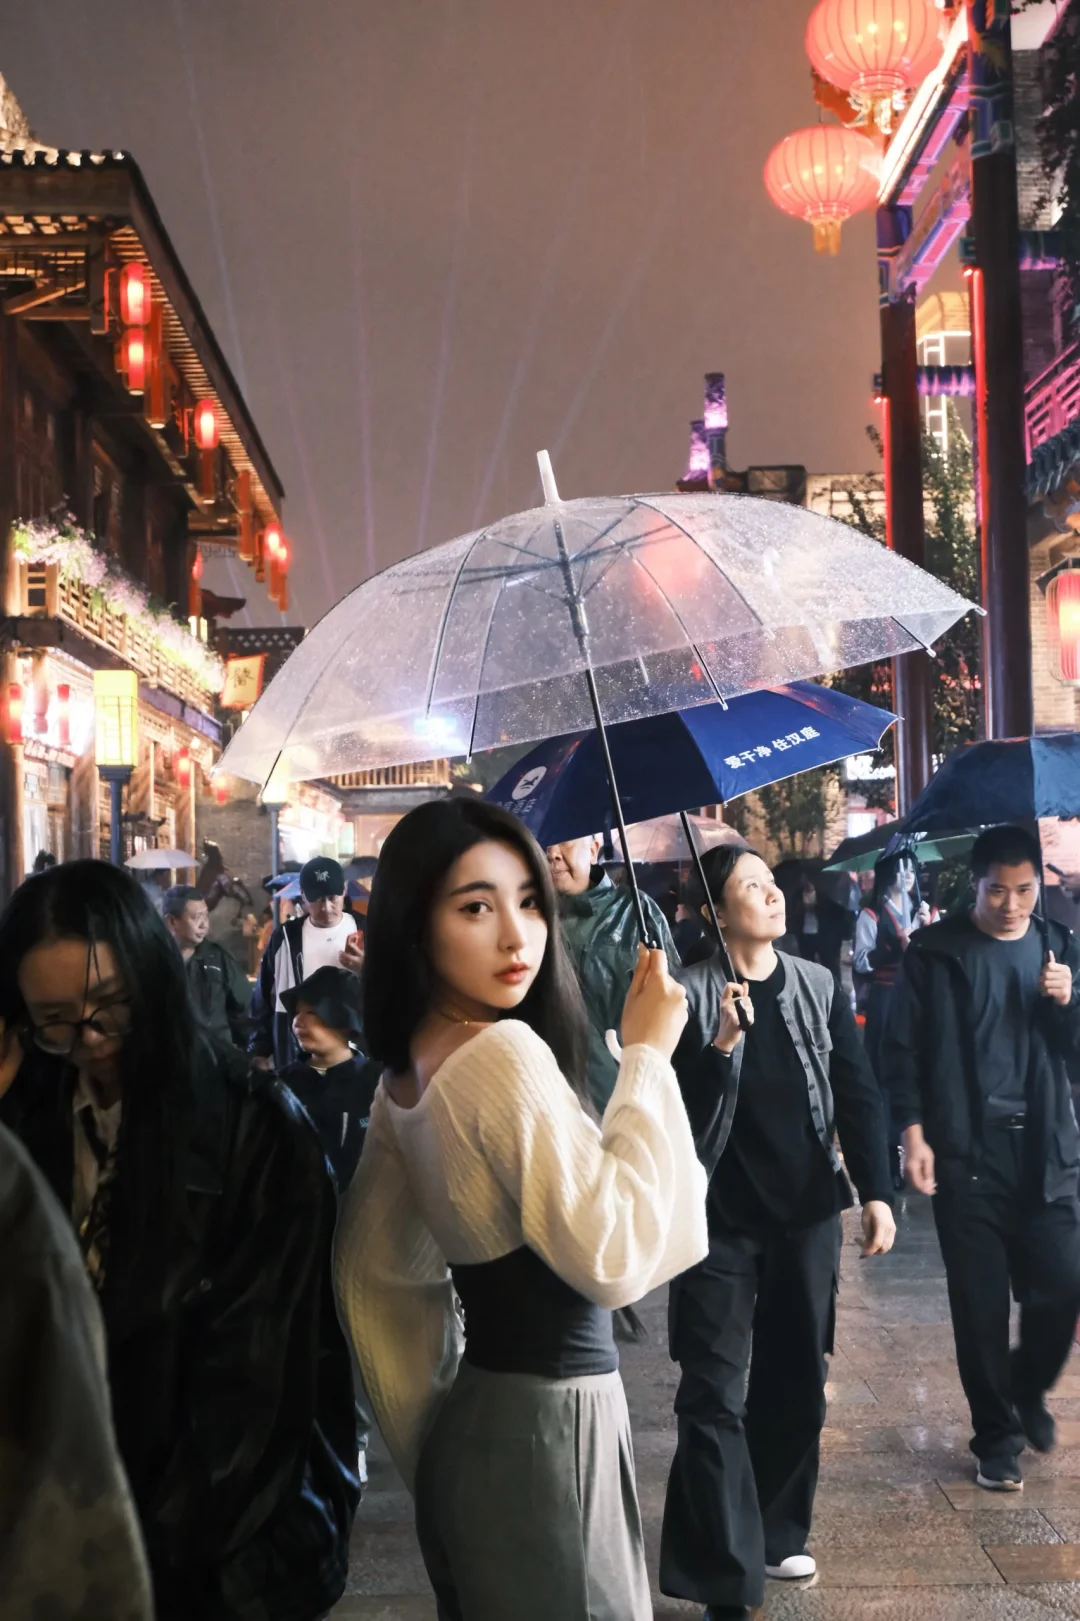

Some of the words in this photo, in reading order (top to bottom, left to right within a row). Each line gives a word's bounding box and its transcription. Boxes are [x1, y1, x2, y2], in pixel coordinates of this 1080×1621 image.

[723, 745, 772, 769] 爱干净
[771, 726, 820, 752] 住汉庭
